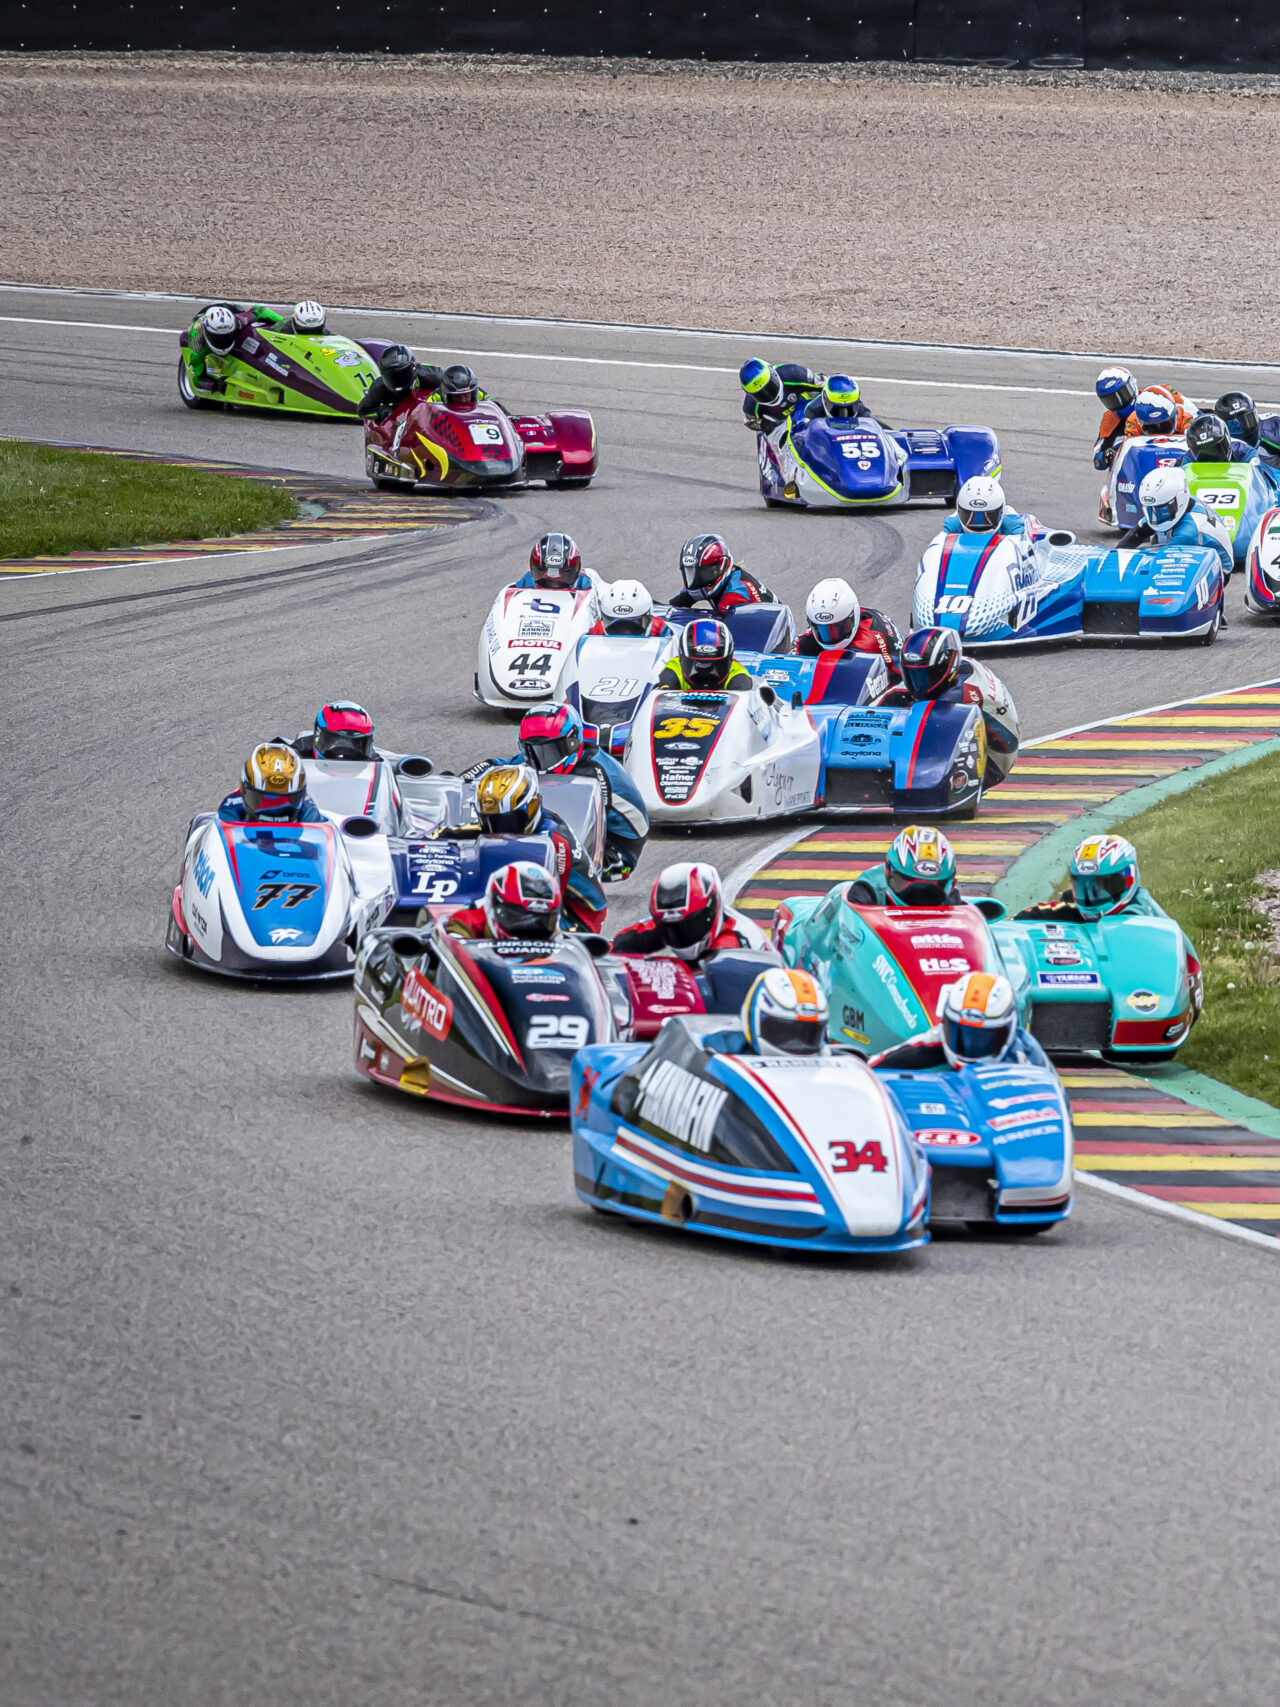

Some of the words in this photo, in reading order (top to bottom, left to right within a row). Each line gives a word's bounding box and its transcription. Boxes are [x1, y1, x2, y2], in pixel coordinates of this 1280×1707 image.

[486, 428, 500, 440] 9
[841, 442, 881, 459] 55
[1203, 494, 1236, 504] 33
[934, 595, 975, 614] 10
[510, 640, 561, 649] MOTUL
[875, 633, 892, 663] wintex
[508, 653, 552, 675] 44
[589, 677, 639, 697] 21
[653, 717, 721, 739] 35
[252, 883, 321, 911] 77
[843, 1004, 865, 1032] GBM
[525, 1014, 590, 1049] 29
[828, 1140, 888, 1173] 34
